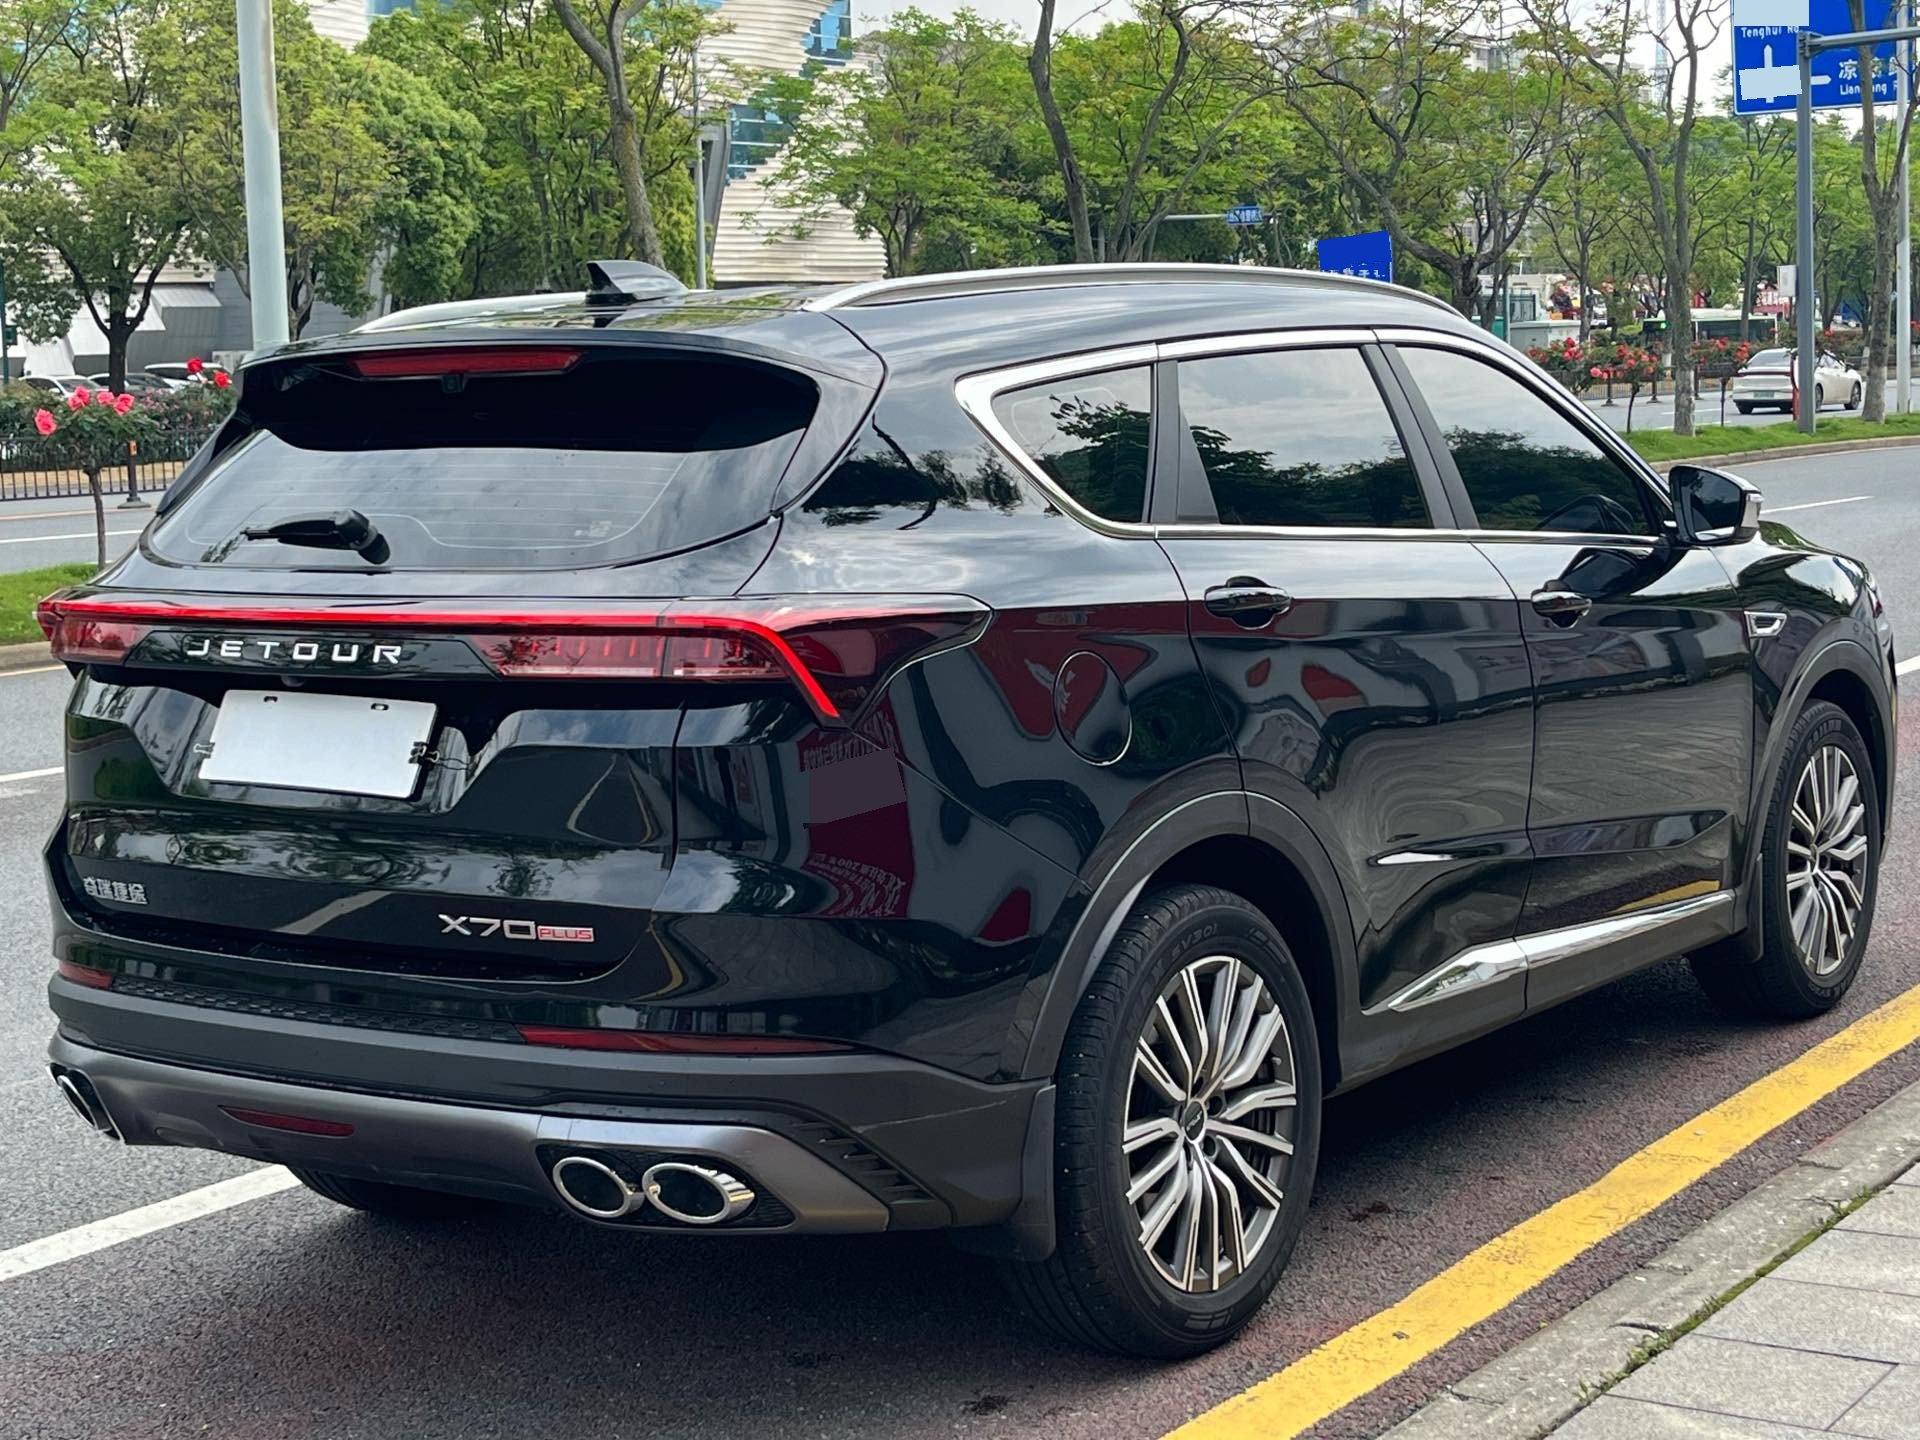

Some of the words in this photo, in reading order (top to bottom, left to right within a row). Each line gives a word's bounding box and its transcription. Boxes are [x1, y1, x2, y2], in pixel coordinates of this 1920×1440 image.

[1741, 26, 1782, 40] Tenghui
[186, 639, 402, 664] JETOUR
[83, 876, 148, 905] 奇瑞捷途
[438, 913, 536, 940] X70
[538, 926, 594, 942] PLUS
